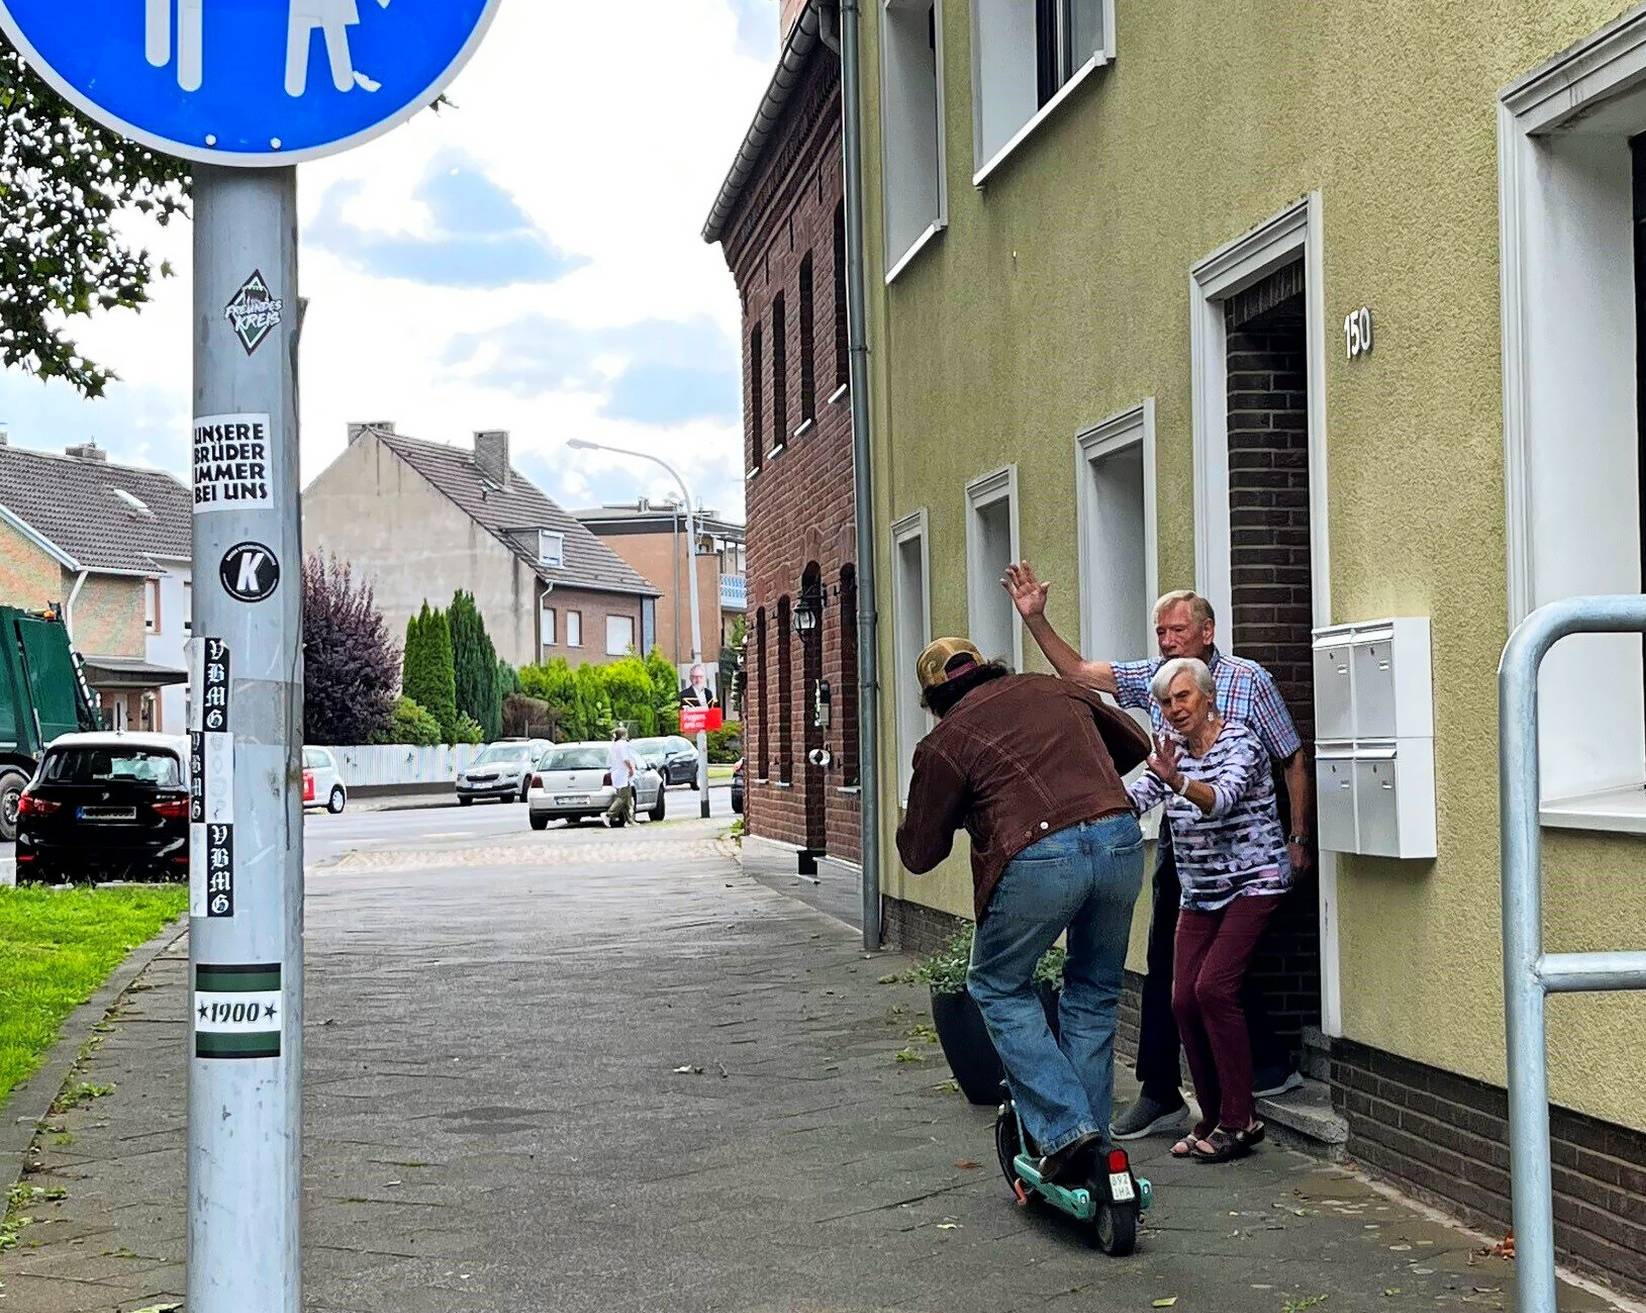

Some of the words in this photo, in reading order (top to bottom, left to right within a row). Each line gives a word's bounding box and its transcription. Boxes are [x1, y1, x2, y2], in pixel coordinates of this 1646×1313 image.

[233, 311, 282, 333] KREIS
[1344, 306, 1371, 359] 150
[195, 423, 264, 445] UNSERE
[195, 462, 266, 485] IMMER
[195, 484, 217, 504] BEI
[223, 482, 268, 500] UNS
[236, 552, 265, 591] K
[211, 1002, 261, 1023] 1900
